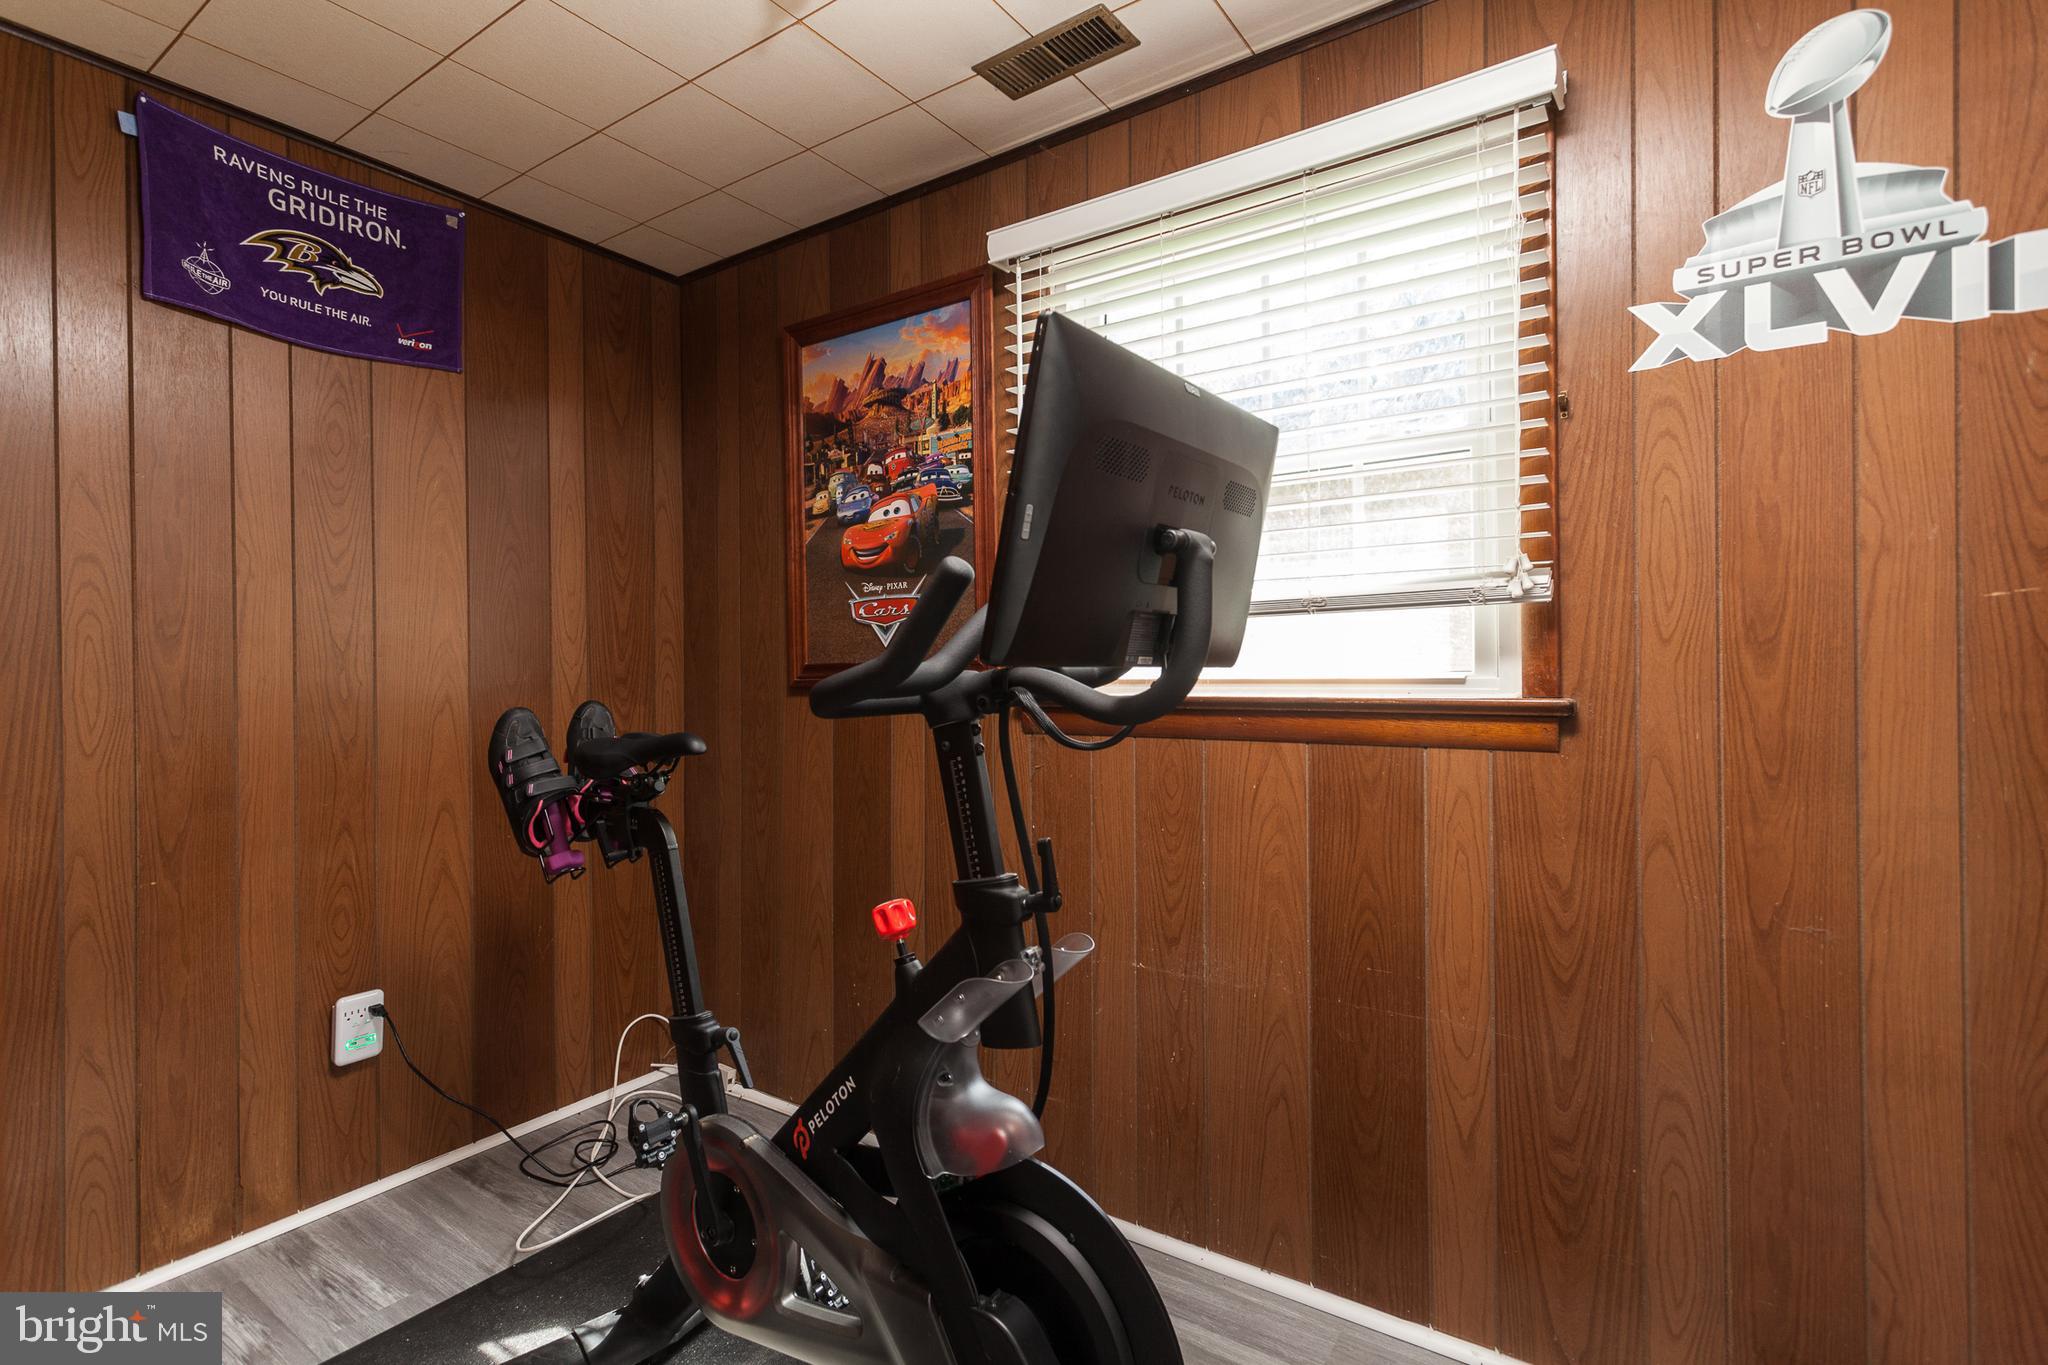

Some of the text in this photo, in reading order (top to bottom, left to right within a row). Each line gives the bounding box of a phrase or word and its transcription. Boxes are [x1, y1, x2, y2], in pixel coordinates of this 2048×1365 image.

[213, 145, 388, 221] RAVENS RULE THE
[1800, 180, 1822, 195] NFL
[268, 188, 407, 250] GRIDIRON.
[1697, 220, 1959, 285] SUPER BOWL
[212, 277, 228, 288] AIR
[260, 286, 372, 328] YOU RULE THE AIR.
[1627, 228, 2048, 372] XLVII
[398, 337, 433, 350] verizon
[1168, 485, 1206, 505] PELOTON
[861, 581, 908, 594] Disney PIXAR
[859, 602, 910, 617] Cars
[808, 1075, 857, 1135] PELOTON
